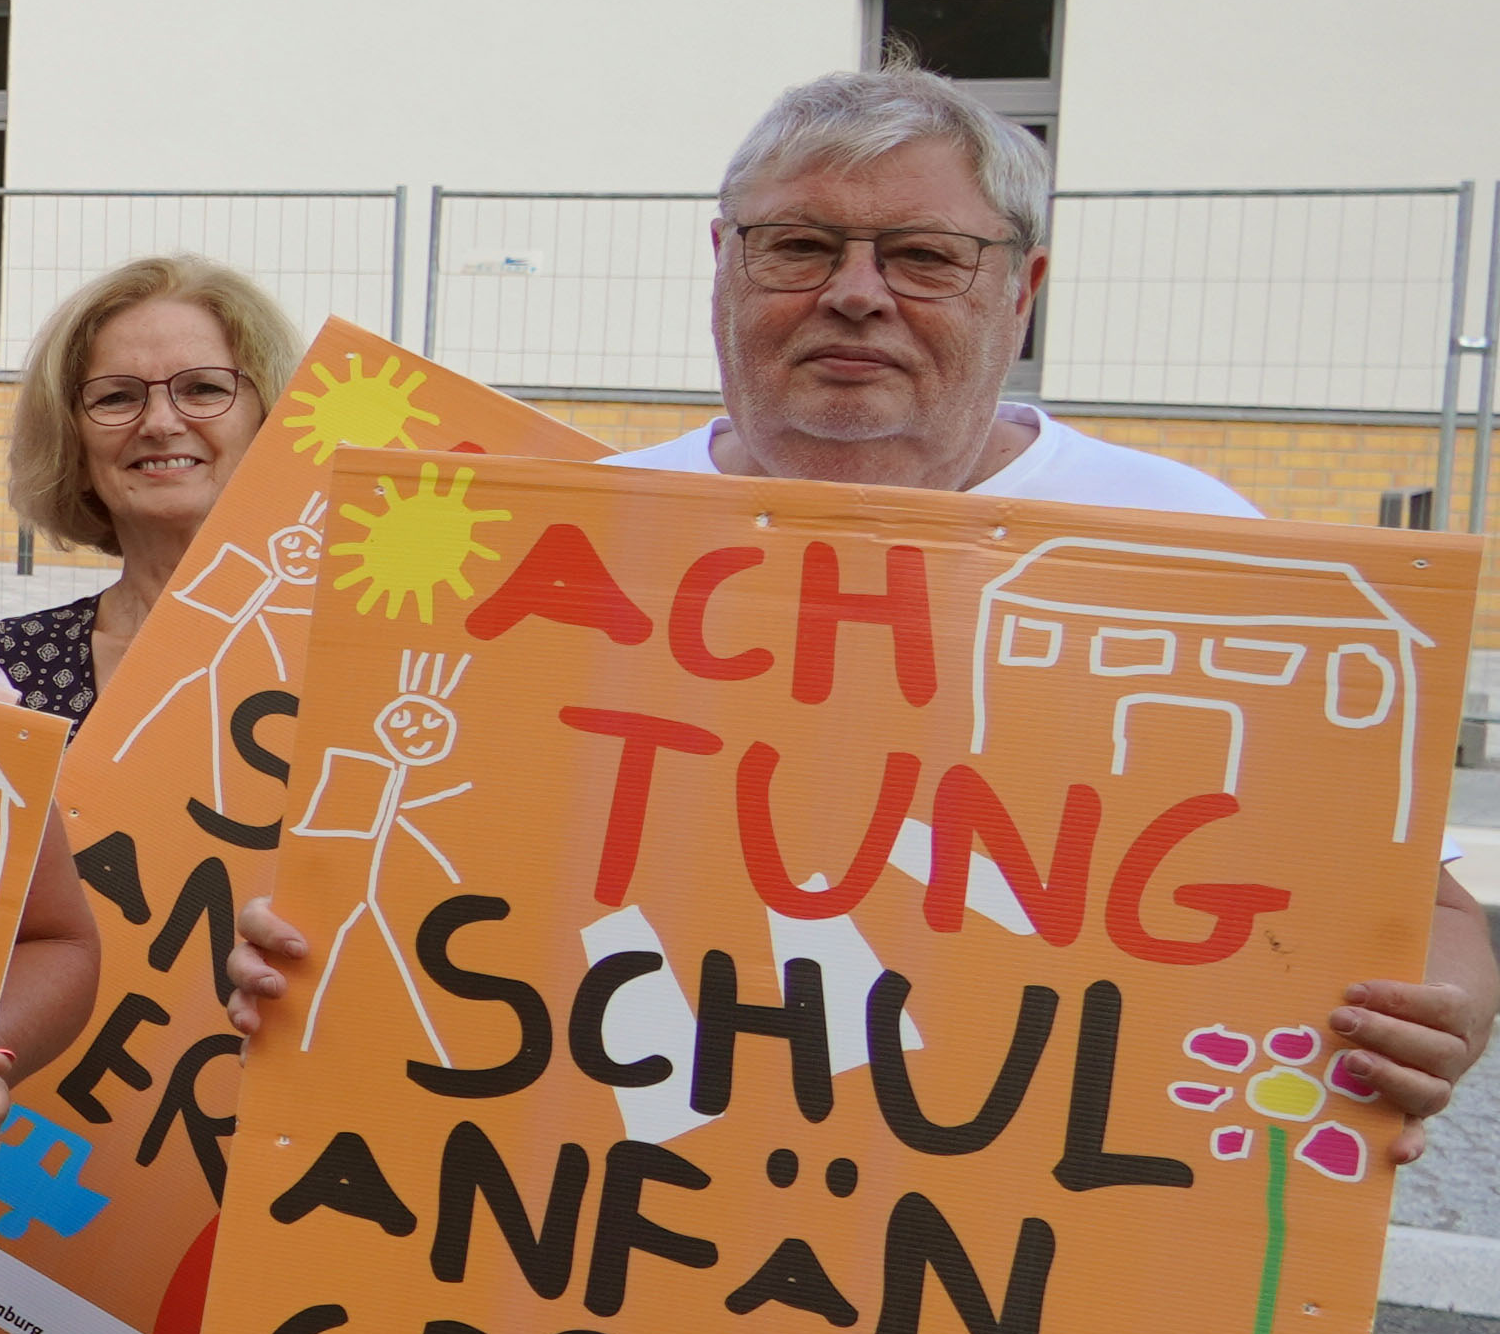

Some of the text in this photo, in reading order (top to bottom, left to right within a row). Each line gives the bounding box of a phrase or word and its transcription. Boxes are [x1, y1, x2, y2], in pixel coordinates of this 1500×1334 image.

[464, 522, 938, 710] ACH
[558, 706, 1293, 966] TUNG
[56, 990, 244, 1208] ER
[406, 892, 1195, 1193] SCHUL
